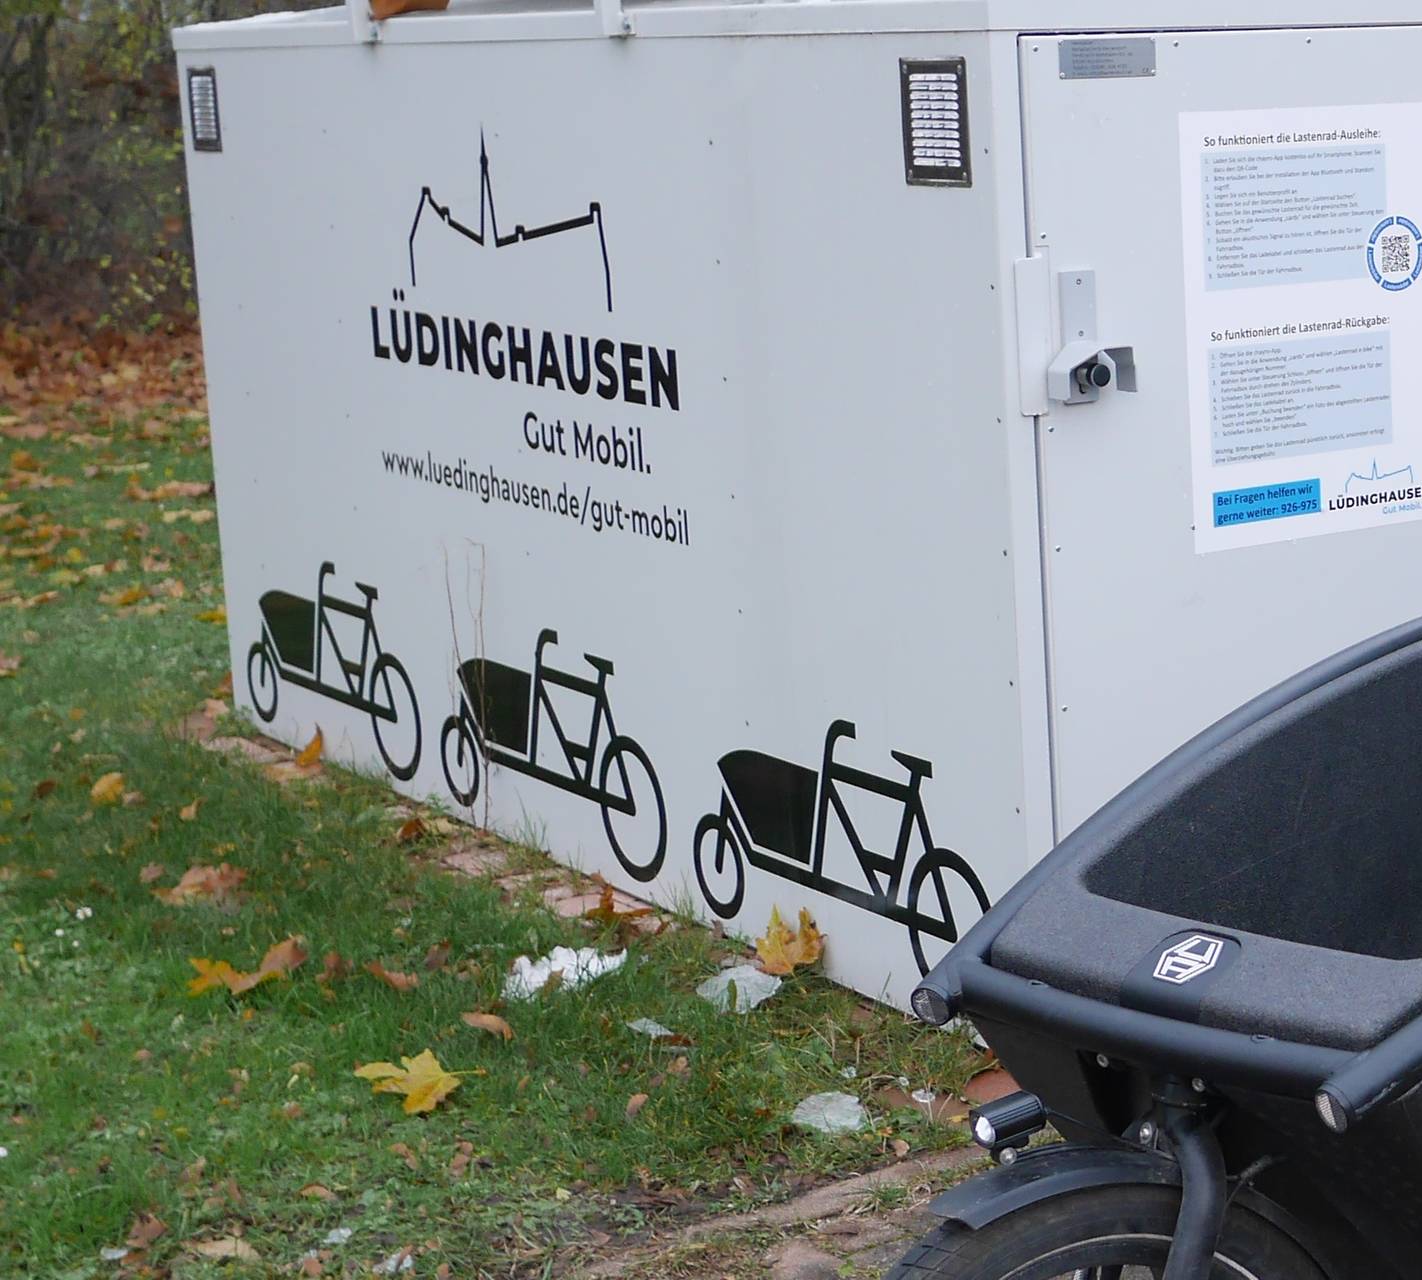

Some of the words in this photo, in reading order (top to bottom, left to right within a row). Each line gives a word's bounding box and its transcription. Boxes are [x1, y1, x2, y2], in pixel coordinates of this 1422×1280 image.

[1204, 136, 1216, 147] So
[1218, 133, 1274, 146] funktioniert
[1276, 132, 1291, 143] die
[1293, 128, 1381, 142] Lastenrad-Ausleihe:
[1210, 331, 1222, 342] So
[1225, 326, 1280, 341] funktioniert
[1282, 323, 1297, 335] die
[1299, 315, 1390, 333] Lastenrad-Rückgabe:
[370, 288, 680, 412] LÜDINGHAUSEN
[523, 411, 566, 456] Gut
[573, 421, 651, 475] Mobil.
[382, 450, 690, 546] www.luedinghausen.de/gut-mobil
[1217, 496, 1232, 506] Bei
[1234, 491, 1266, 504] Fragen
[1267, 487, 1297, 500] helfen
[1298, 483, 1313, 495] wir
[1217, 511, 1245, 525] gerne
[1246, 506, 1280, 519] weiter:
[1281, 499, 1318, 513] 926-975
